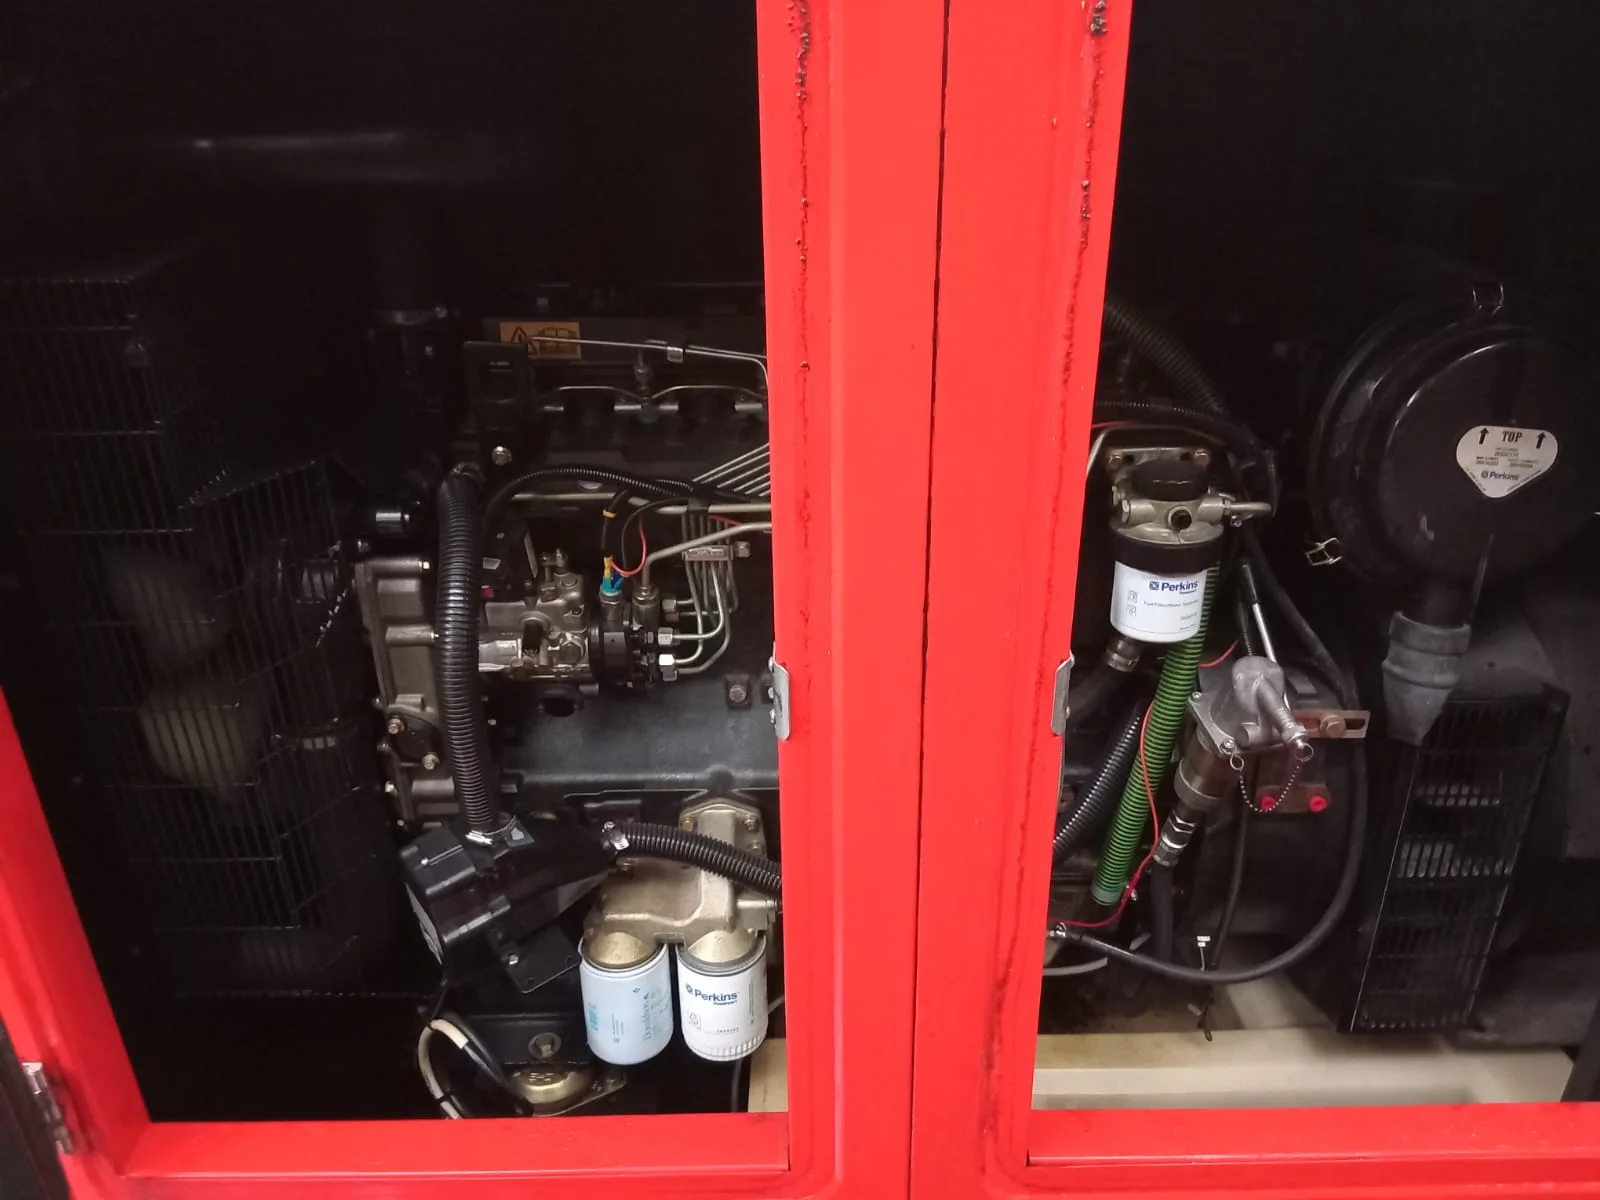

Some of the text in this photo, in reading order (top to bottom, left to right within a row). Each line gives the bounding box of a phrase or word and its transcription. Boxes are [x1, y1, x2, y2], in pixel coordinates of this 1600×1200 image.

[1501, 430, 1523, 443] TOP
[1489, 471, 1519, 481] Perkins
[1161, 580, 1198, 591] Perkins
[694, 988, 738, 1001] Perkins
